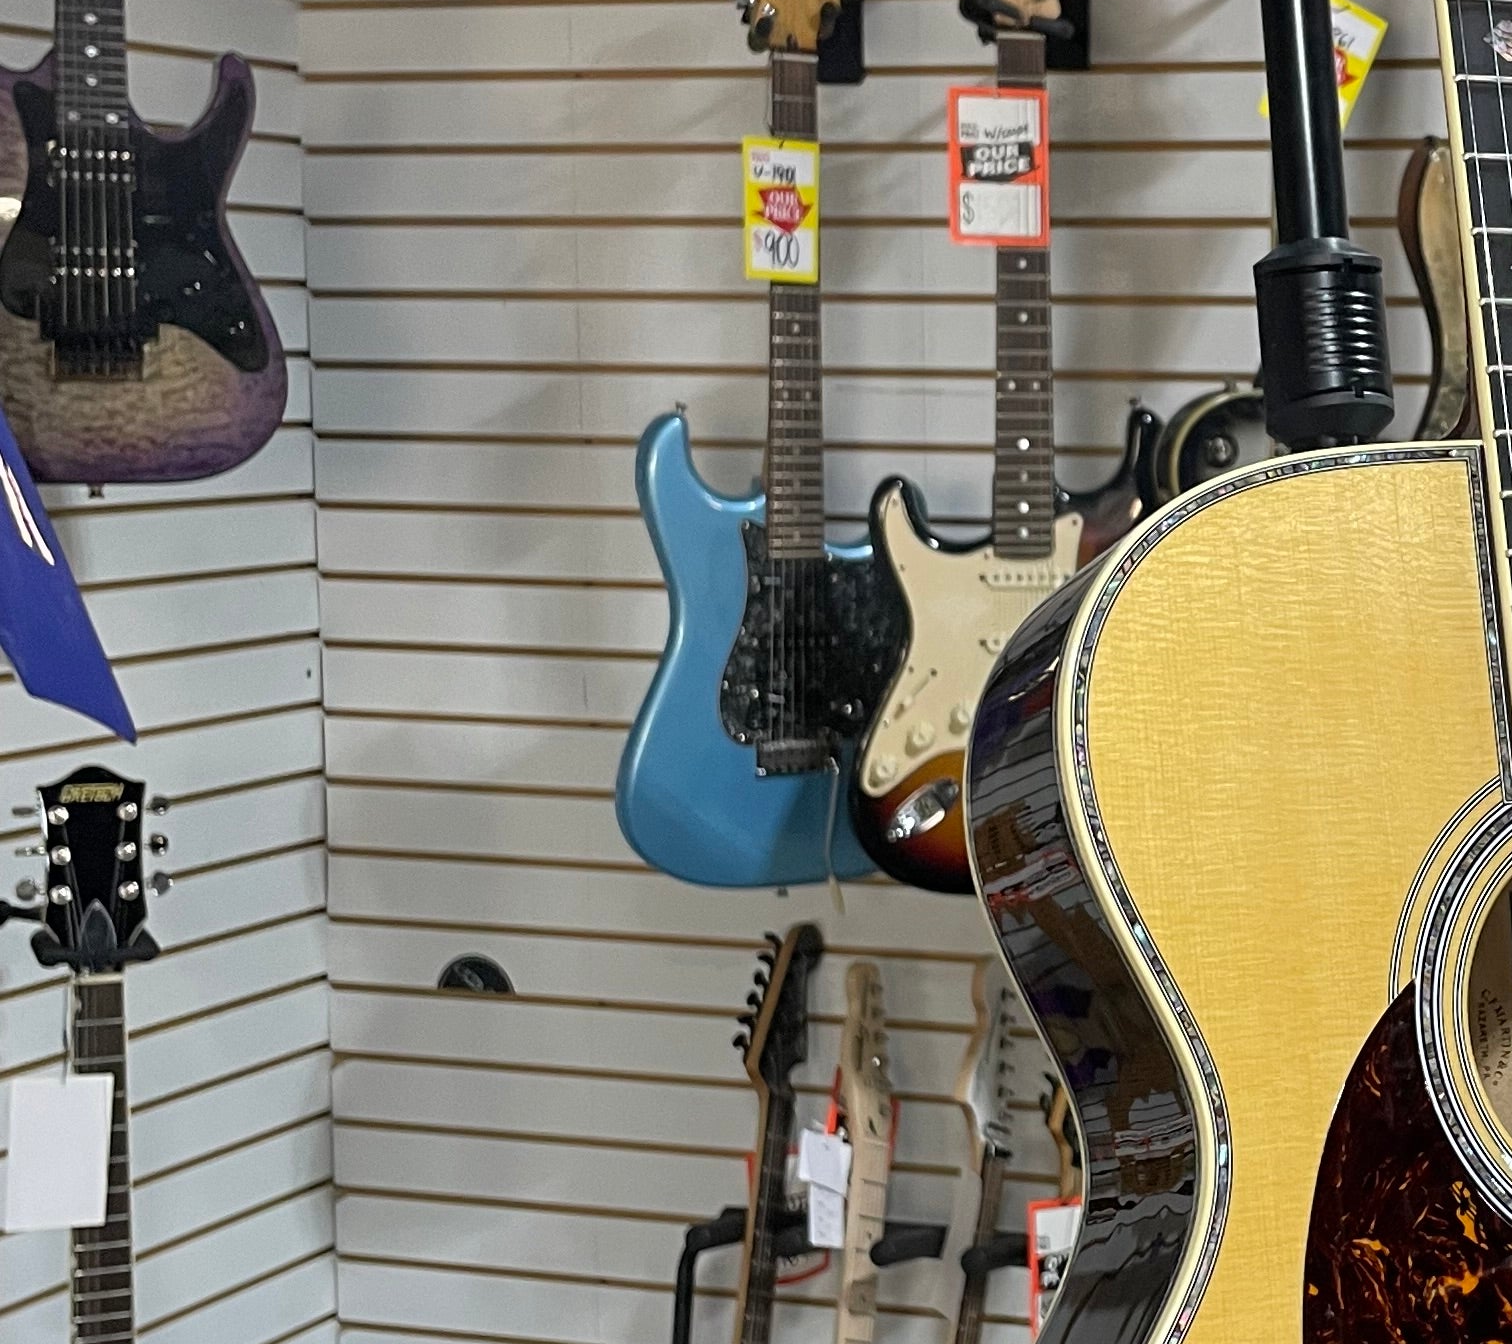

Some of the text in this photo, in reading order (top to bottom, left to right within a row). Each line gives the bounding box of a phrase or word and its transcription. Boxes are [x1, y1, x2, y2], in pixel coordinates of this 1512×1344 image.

[975, 143, 1020, 161] OUR
[967, 157, 1031, 178] PRICE
[768, 189, 798, 206] OUR
